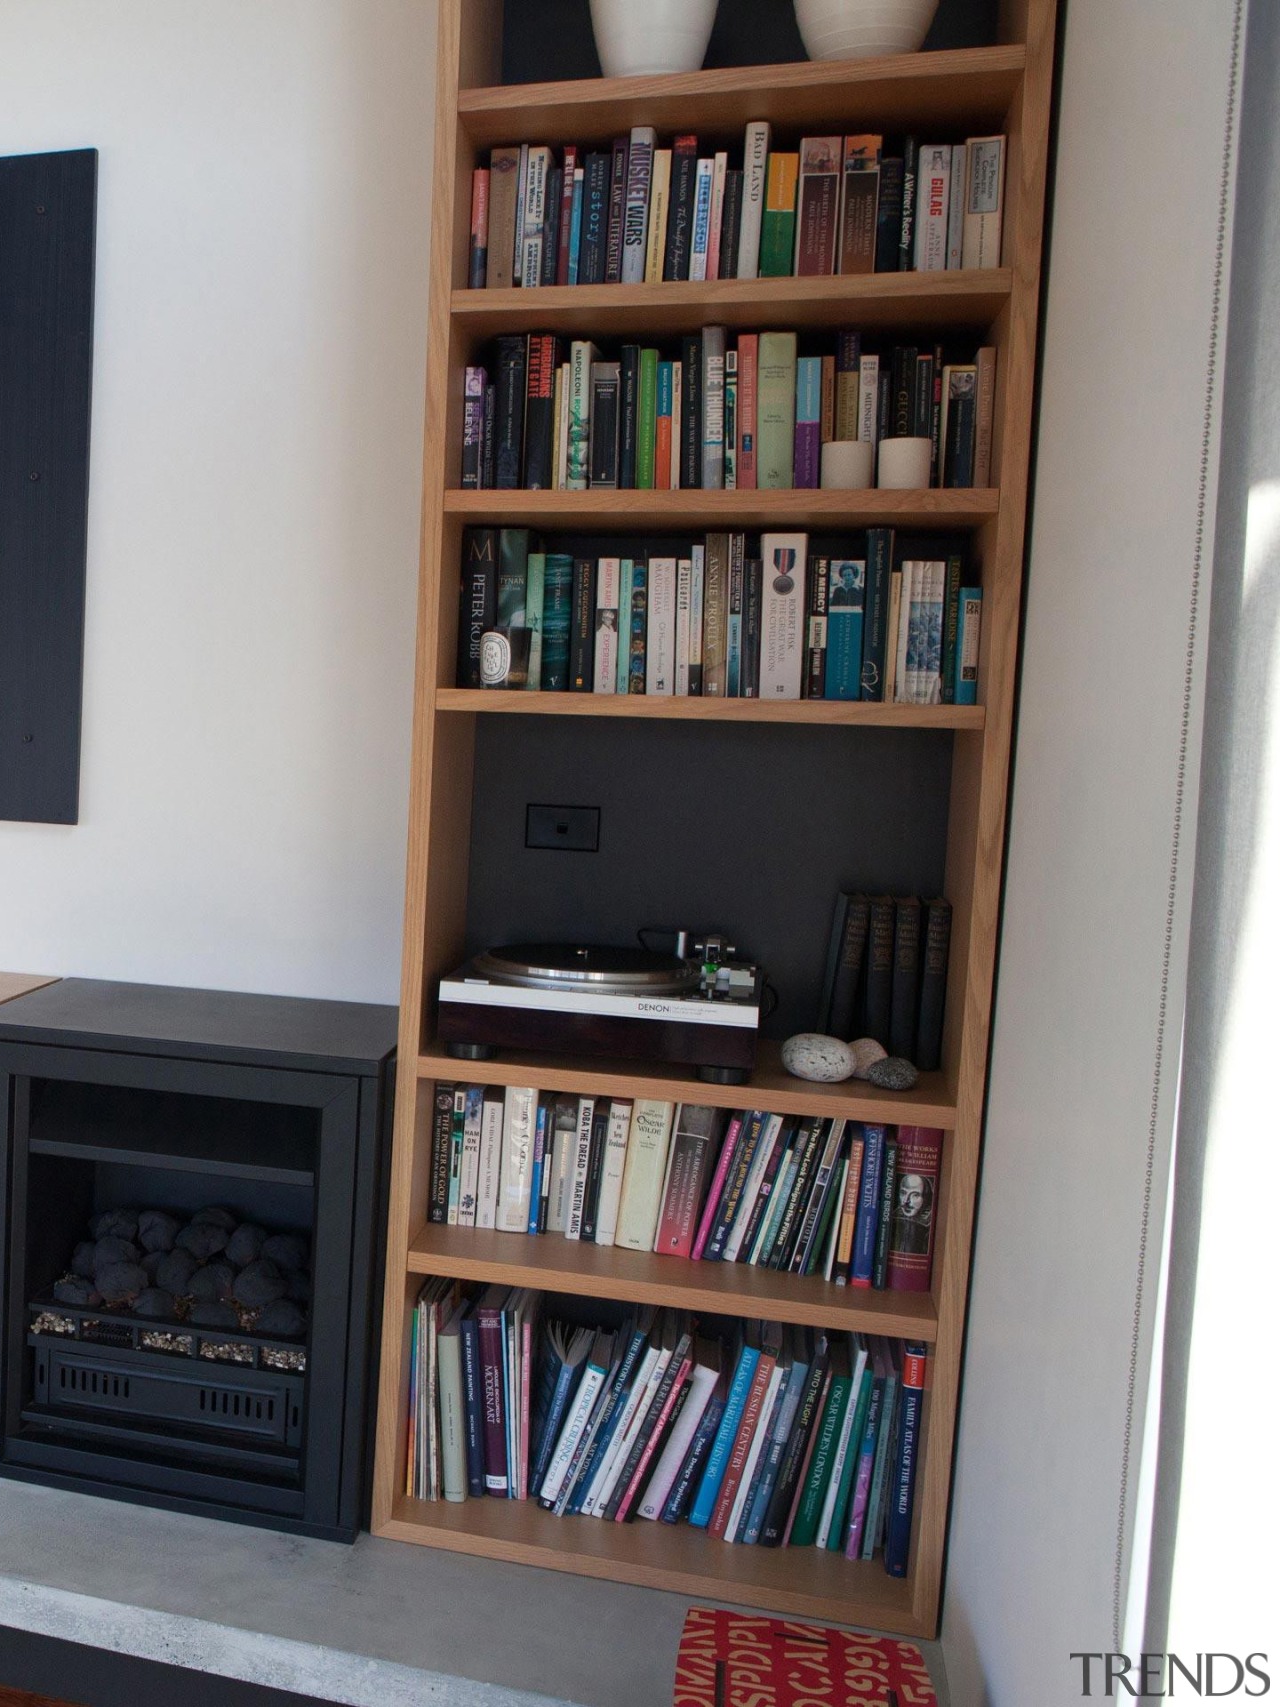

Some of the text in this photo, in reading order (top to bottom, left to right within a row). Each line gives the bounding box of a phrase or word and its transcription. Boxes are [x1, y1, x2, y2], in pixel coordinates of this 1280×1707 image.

[751, 131, 765, 202] BAD LAND
[626, 143, 651, 246] MUSKET WARS
[695, 176, 710, 252] BILL BRYSON
[930, 178, 943, 216] GULAG
[586, 192, 602, 242] story
[899, 217, 911, 250] Reality
[528, 338, 540, 398] AT THE GATE
[539, 336, 553, 398] BARBARIANS
[707, 356, 723, 442] BLUE THUNDER
[863, 392, 873, 437] MIDNIGHT
[897, 391, 908, 435] GUCCI
[464, 402, 472, 446] BELIEVING
[654, 563, 662, 614] MAUGHAM
[679, 567, 690, 610] Postcards
[707, 555, 718, 650] ANNIE PROULX
[817, 560, 827, 613] NO MERCY
[470, 574, 486, 659] PETER ROBB
[581, 590, 589, 638] GUGGENHEIM
[601, 634, 610, 680] EXPERIENCE
[767, 616, 776, 672] CIVILISATION
[638, 1003, 670, 1012] DENON
[637, 1116, 664, 1127] OSCAR
[638, 1126, 661, 1136] WILDE
[751, 1122, 760, 1138] HOW
[809, 1128, 820, 1141] The
[438, 1114, 450, 1204] THE POWER OF GOLD
[570, 1106, 591, 1234] KOBA THE DREAD MARTIN AMIS
[798, 1158, 811, 1176] Look
[804, 1141, 816, 1158] New
[853, 1142, 863, 1160] fast
[667, 1152, 683, 1221] ANTHONY SUMMERS
[681, 1141, 703, 1237] THE ARROGANCE OF POWER
[735, 1164, 750, 1188] AROUND
[789, 1177, 804, 1203] Design
[883, 1150, 895, 1222] NEW ZEALAND BIRDS
[725, 1201, 736, 1223] WORLD
[785, 1209, 794, 1222] the
[846, 1188, 858, 1212] boats
[776, 1222, 789, 1246] Fifties
[670, 1354, 684, 1376] THE
[737, 1352, 753, 1377] ATLAS
[759, 1364, 771, 1383] THE
[908, 1358, 919, 1385] COLLINS
[484, 1365, 495, 1424] MODERN ART
[577, 1337, 641, 1483] THE HISTORY OF SURFING NAT YOUNG
[648, 1377, 675, 1421] ARRIVAL
[743, 1384, 766, 1425] RUSSIAN
[799, 1369, 822, 1426] INTO THE LIGHT
[827, 1385, 844, 1414] OSCAR
[559, 1384, 596, 1462] TROPICAL CRUISING
[717, 1394, 737, 1440] MARITIME
[707, 1442, 727, 1480] HISTORY
[731, 1426, 753, 1471] CENTURY
[810, 1451, 827, 1490] LONDON
[898, 1397, 916, 1514] FAMILY ATLAS OF THE WORLD
[670, 1437, 707, 1512] Yacht Design Explained
[724, 1478, 736, 1498] Brian
